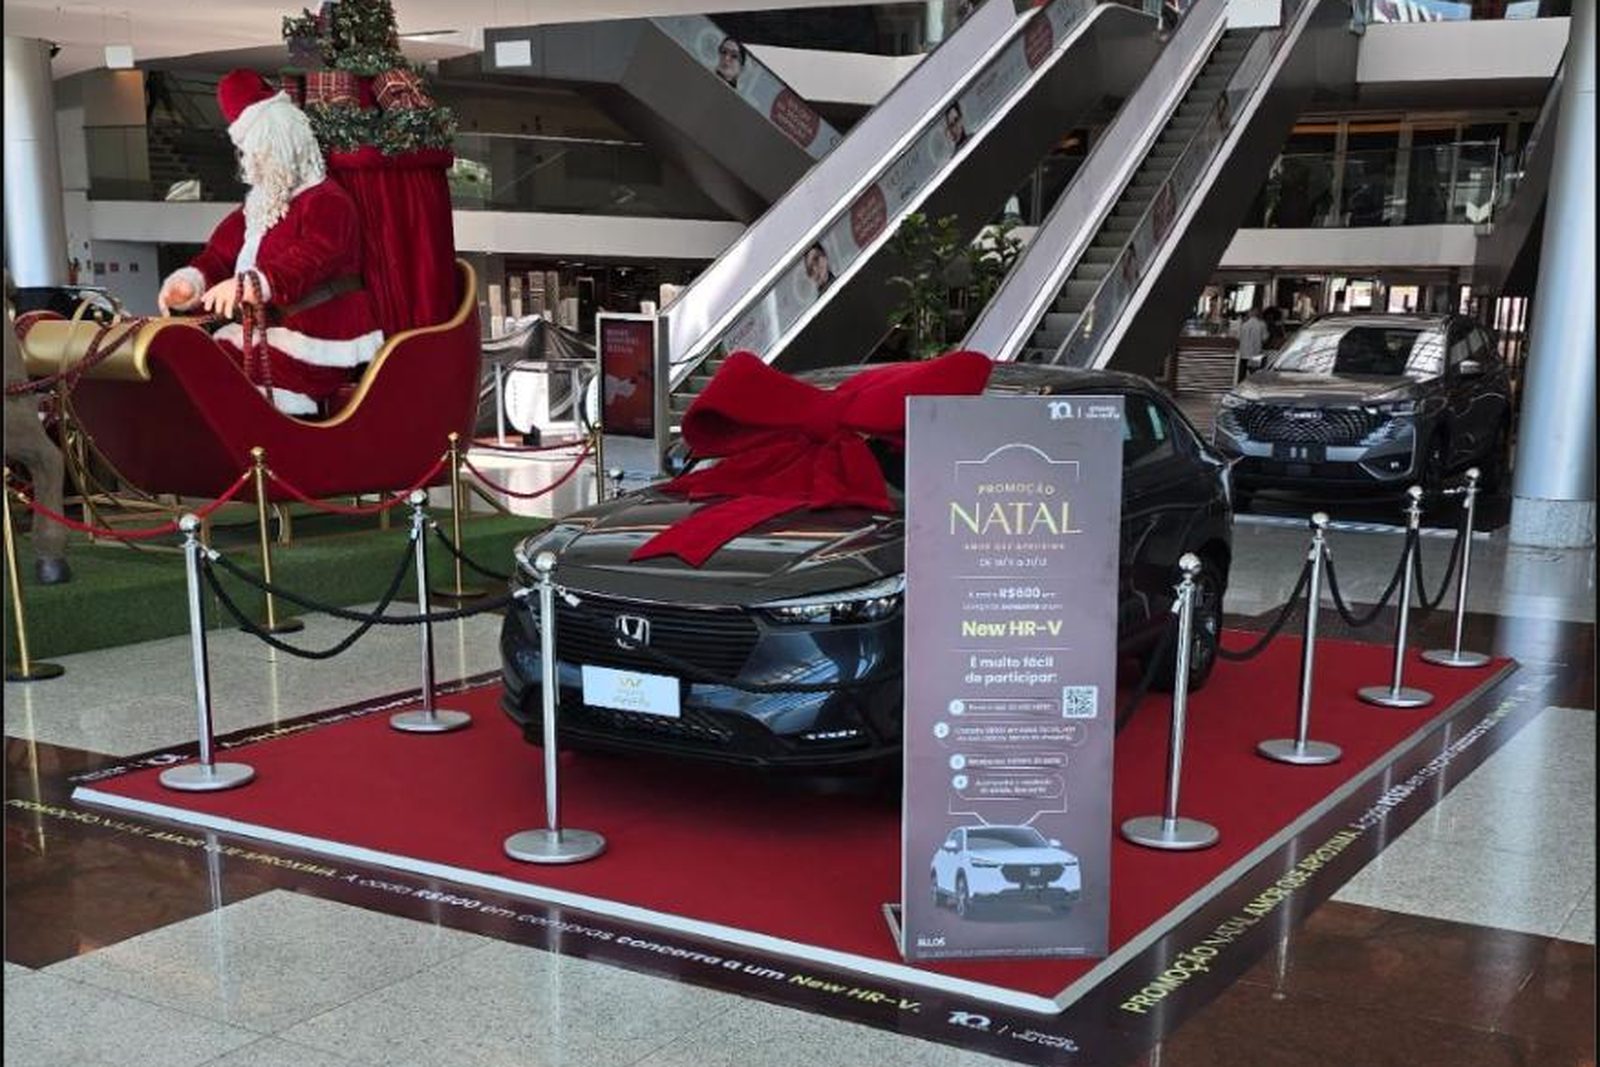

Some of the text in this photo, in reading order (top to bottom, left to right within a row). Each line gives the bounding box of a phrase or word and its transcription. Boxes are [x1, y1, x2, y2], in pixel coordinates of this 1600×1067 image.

[950, 501, 1083, 535] NATAL
[962, 620, 1063, 636] New HR-V
[980, 655, 1020, 668] muito
[480, 903, 516, 918] em
[517, 913, 615, 941] compras
[616, 935, 723, 965] concorra
[722, 959, 742, 971] a
[743, 964, 786, 981] um
[788, 975, 848, 993] New
[1120, 945, 1219, 1015] PROMOÇÃO
[1243, 886, 1294, 918] AMOR
